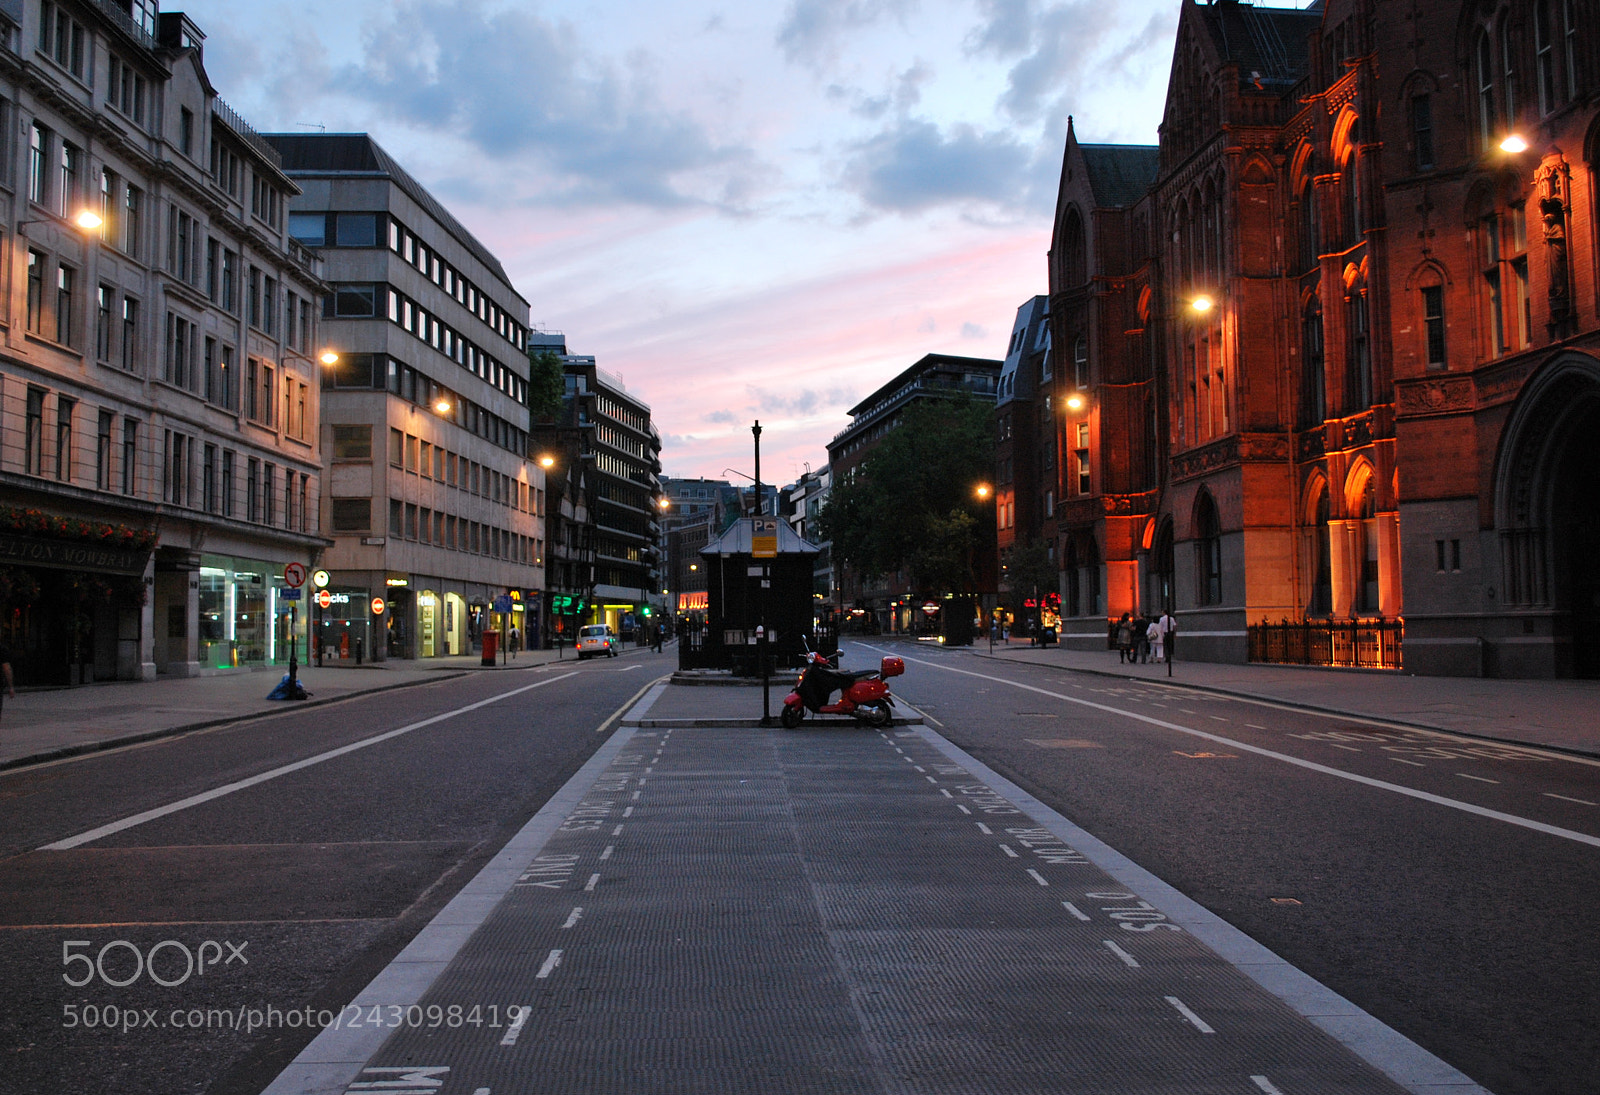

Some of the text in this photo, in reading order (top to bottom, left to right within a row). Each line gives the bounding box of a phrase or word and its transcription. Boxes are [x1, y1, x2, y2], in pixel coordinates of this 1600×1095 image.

[754, 520, 764, 531] P
[1378, 746, 1554, 761] BUS
[955, 785, 1021, 814] CYCLES
[559, 801, 615, 831] CYCLES
[1005, 828, 1089, 864] MOTOR
[514, 854, 580, 889] ONLY
[1085, 892, 1182, 932] SOLO
